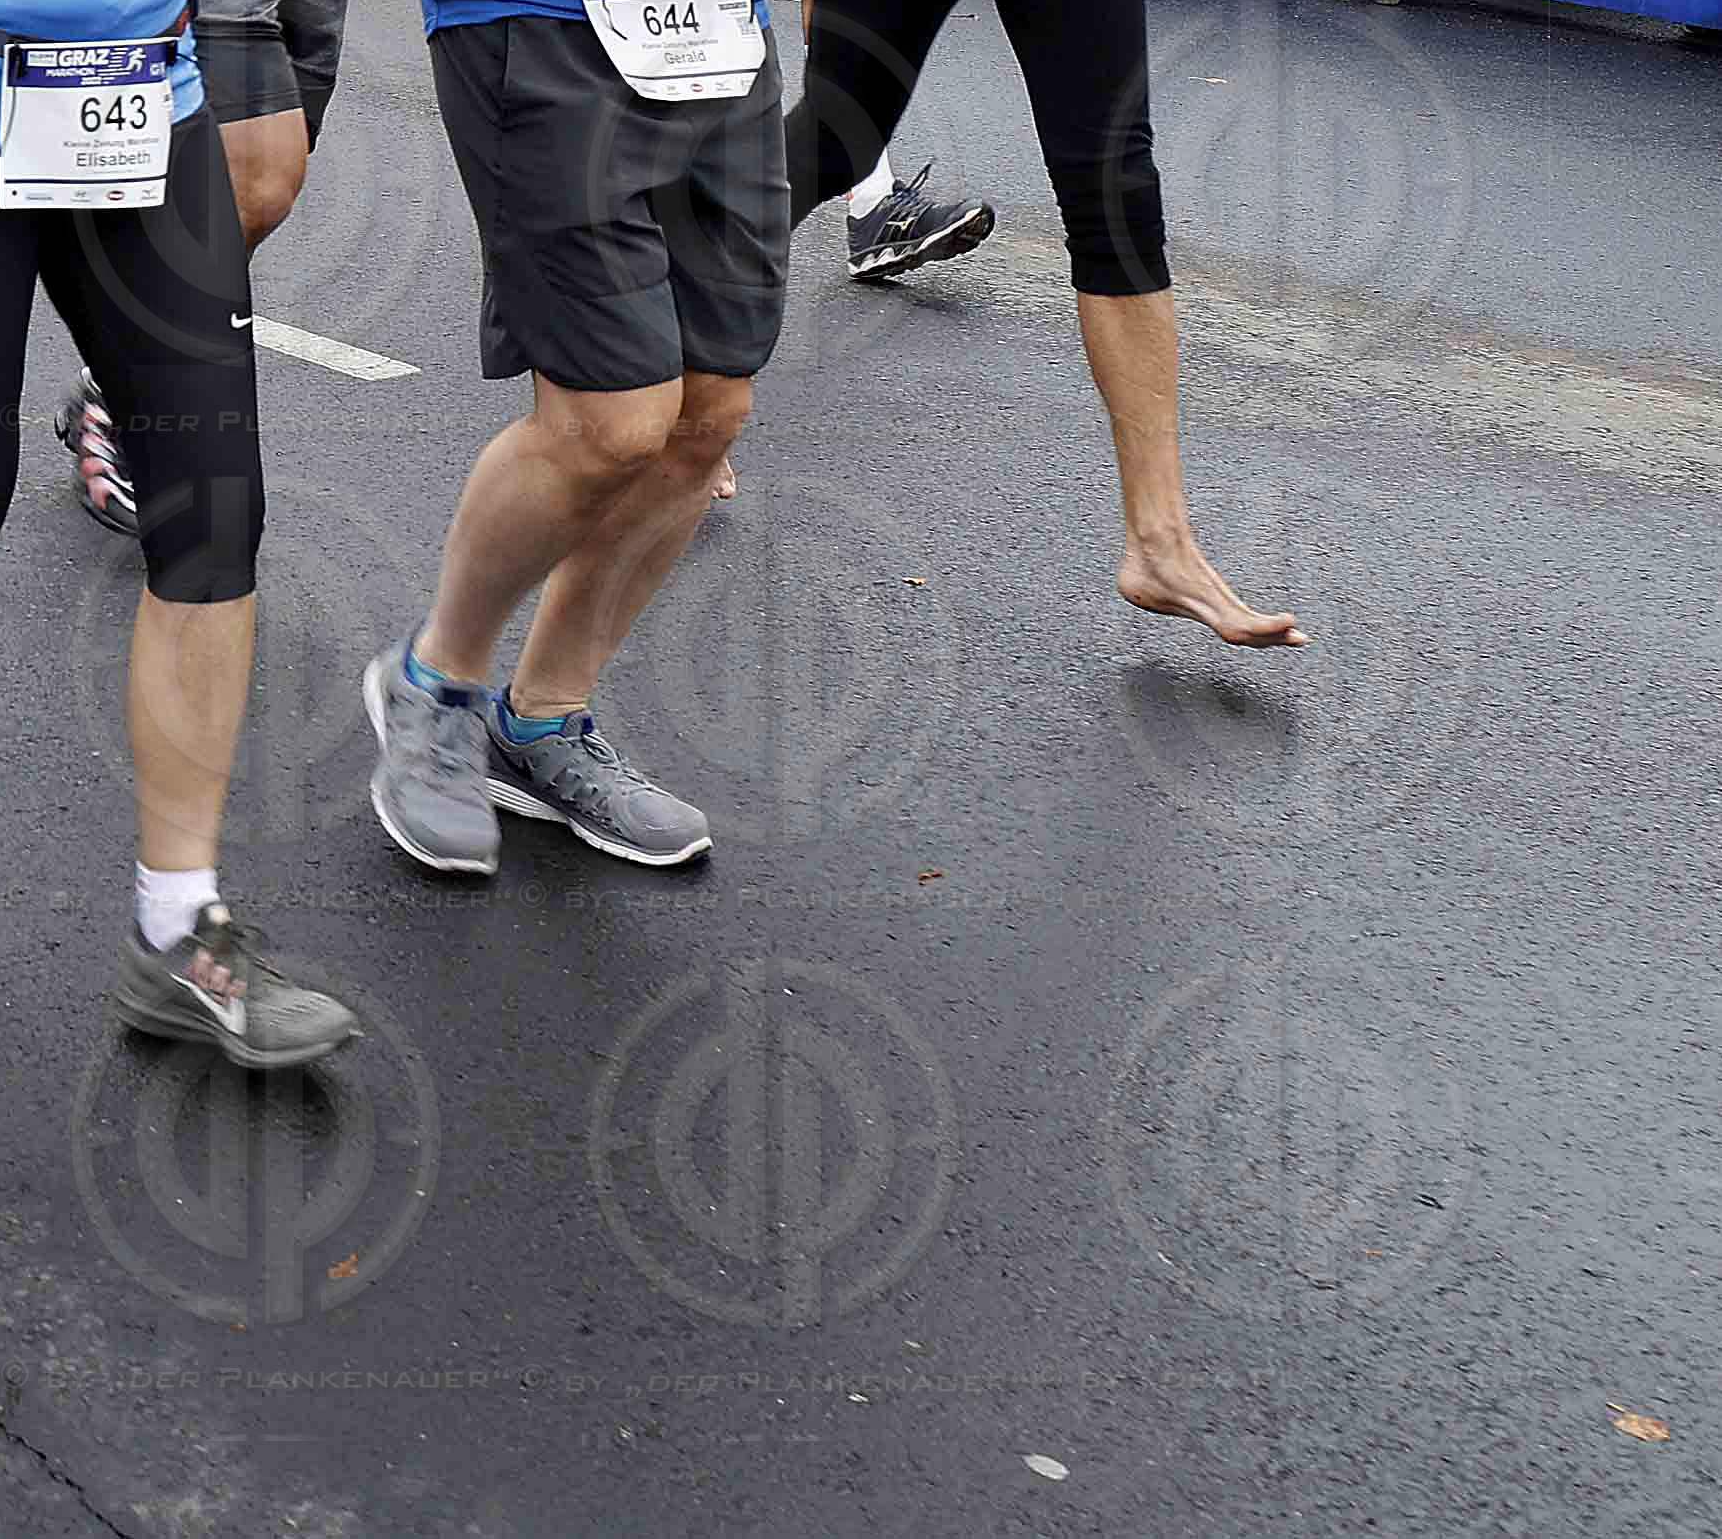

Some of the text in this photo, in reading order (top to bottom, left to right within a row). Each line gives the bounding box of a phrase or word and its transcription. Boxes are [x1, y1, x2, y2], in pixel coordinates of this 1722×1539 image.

[643, 2, 700, 36] 644
[58, 49, 110, 67] GRAZ
[664, 51, 707, 65] Gerald
[81, 95, 148, 132] 643
[76, 152, 150, 167] Elisabeth
